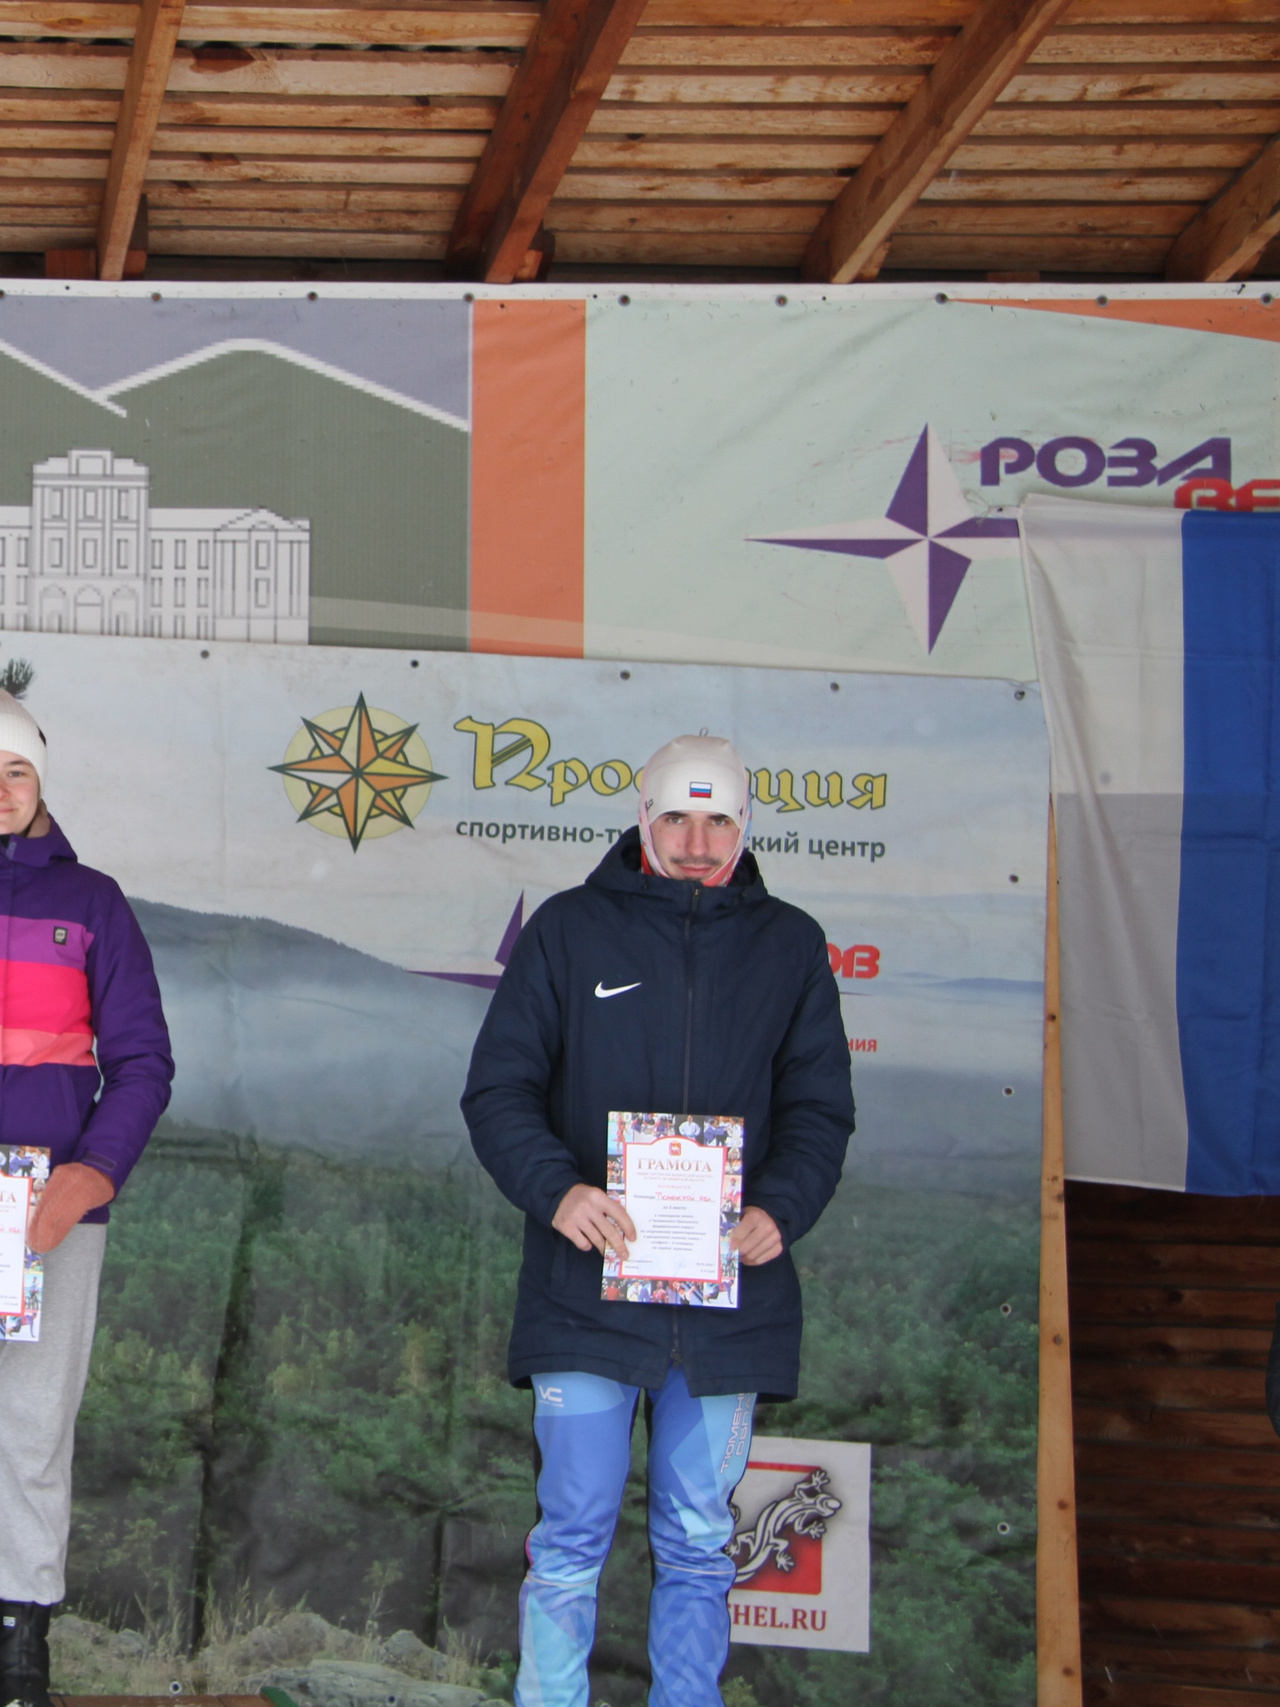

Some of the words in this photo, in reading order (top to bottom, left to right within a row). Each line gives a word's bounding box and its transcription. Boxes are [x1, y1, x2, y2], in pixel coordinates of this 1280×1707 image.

[980, 436, 1232, 488] РОЗА
[808, 838, 885, 863] центр
[637, 1157, 713, 1173] ГРАМОТА
[728, 1603, 828, 1631] HEL.RU
